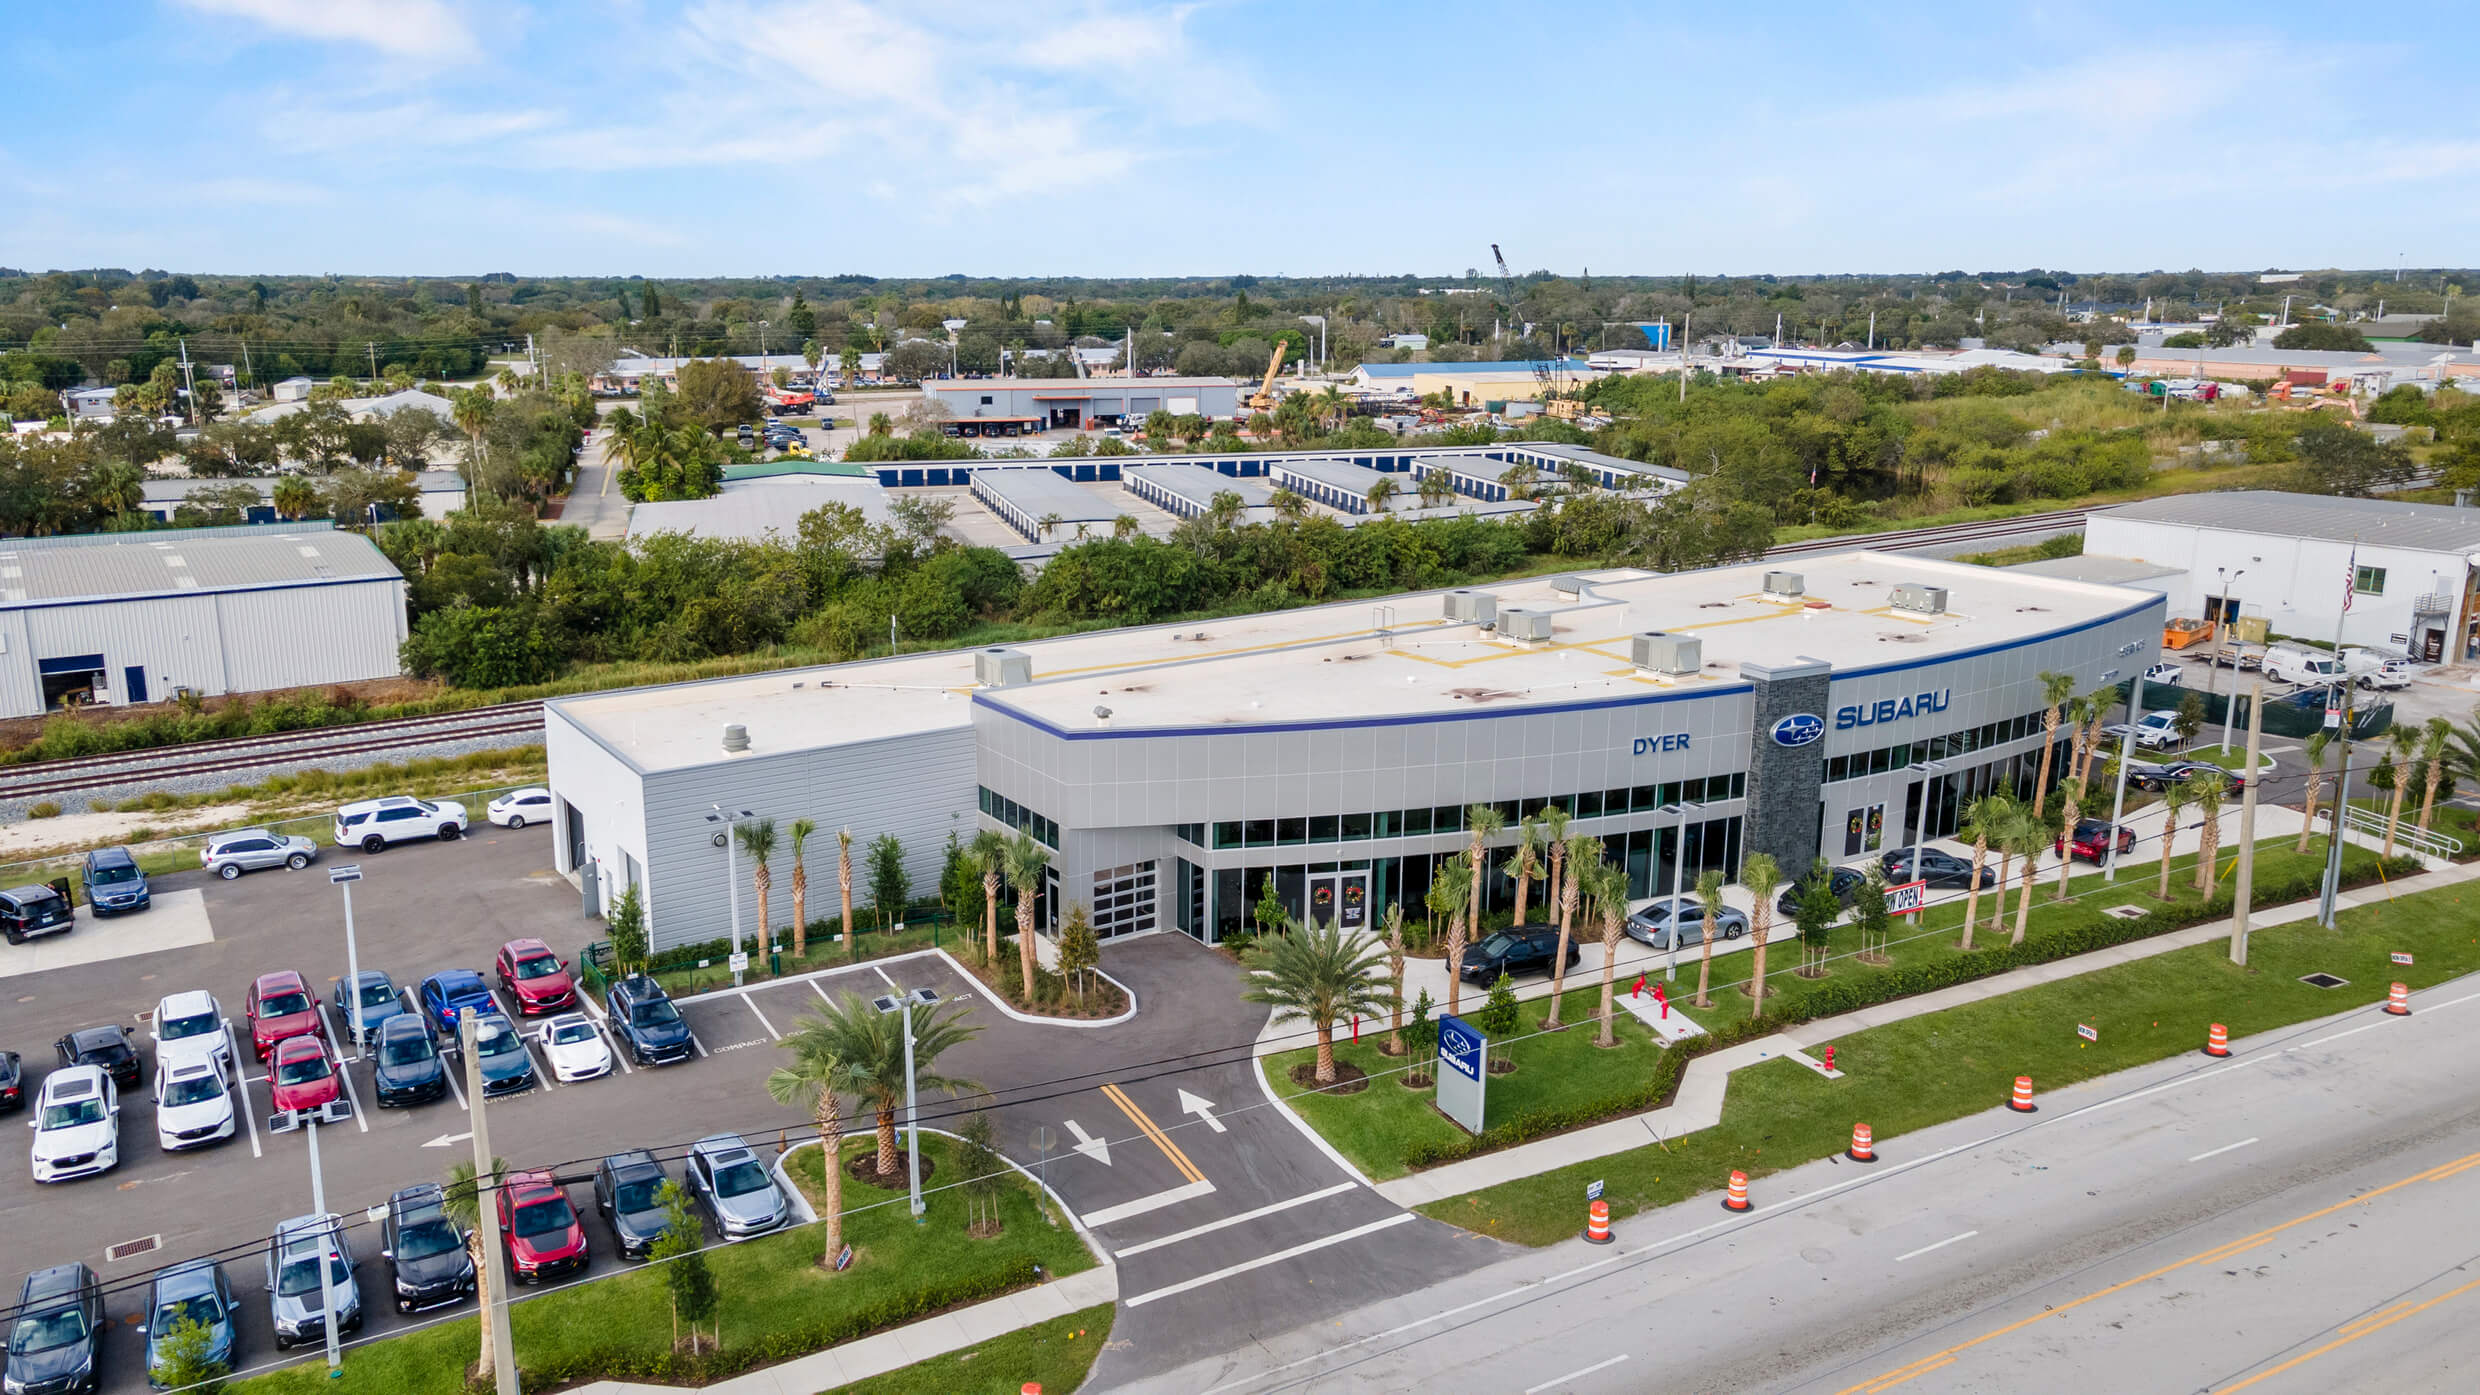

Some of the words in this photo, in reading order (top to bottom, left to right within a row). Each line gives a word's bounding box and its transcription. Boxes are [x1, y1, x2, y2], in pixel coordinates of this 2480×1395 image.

[1836, 688, 1949, 730] SUBARU
[1633, 733, 1690, 755] DYER
[713, 1038, 768, 1054] COMPACT
[1440, 1047, 1474, 1075] SUBARU
[483, 1088, 537, 1105] OMPACT
